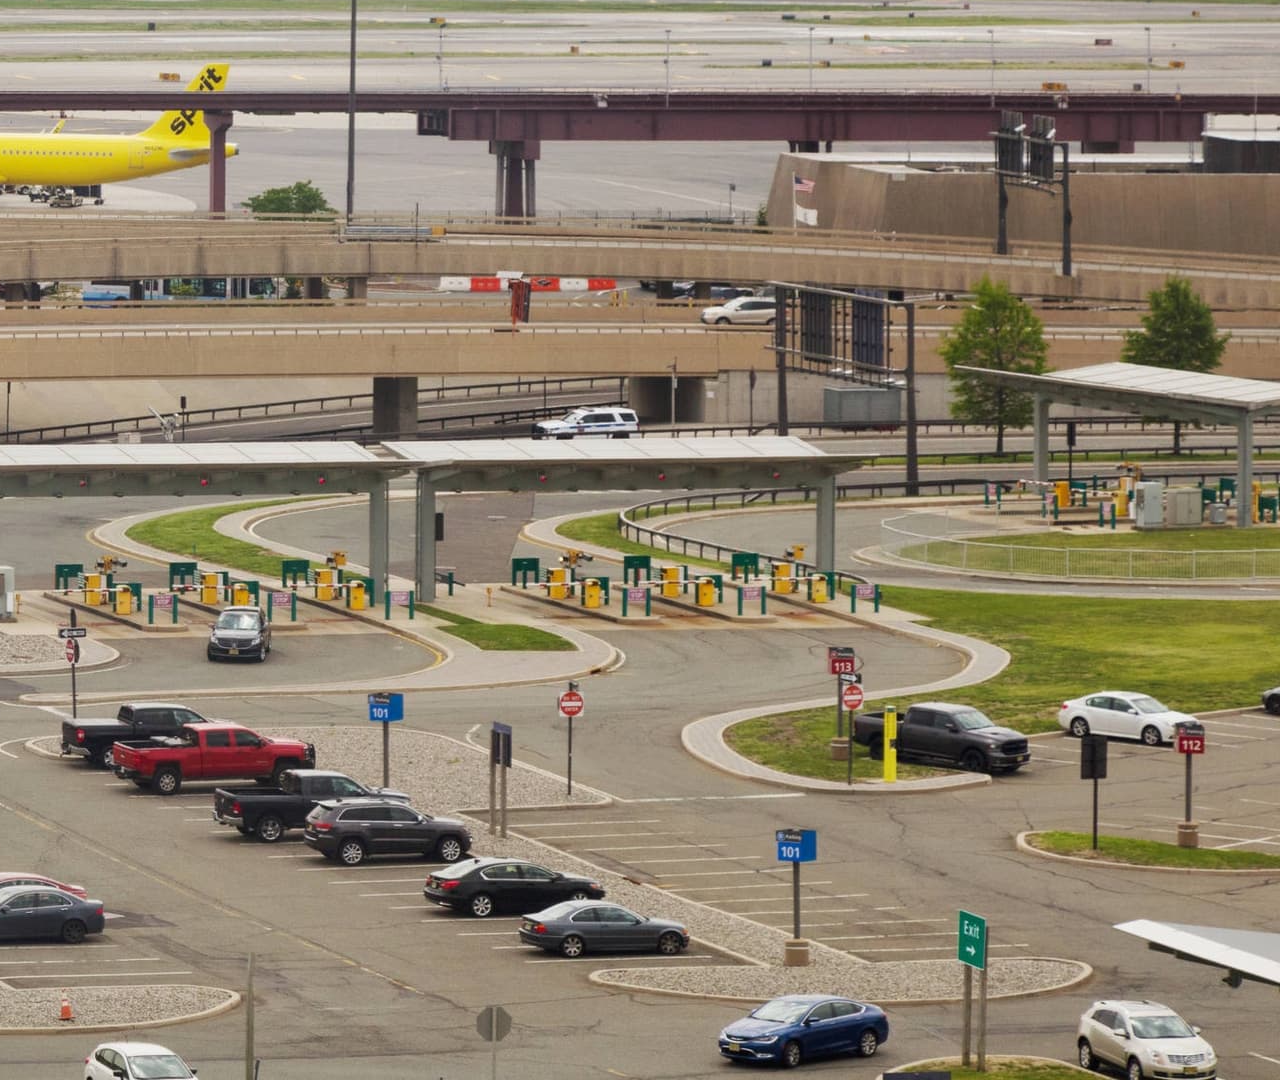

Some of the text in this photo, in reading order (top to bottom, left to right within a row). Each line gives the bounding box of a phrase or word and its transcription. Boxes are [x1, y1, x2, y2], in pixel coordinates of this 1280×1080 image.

[170, 68, 222, 135] spit
[834, 662, 852, 672] 113
[373, 708, 388, 718] 101
[1182, 740, 1200, 750] 112
[781, 846, 800, 858] 101
[964, 920, 979, 939] Exit
